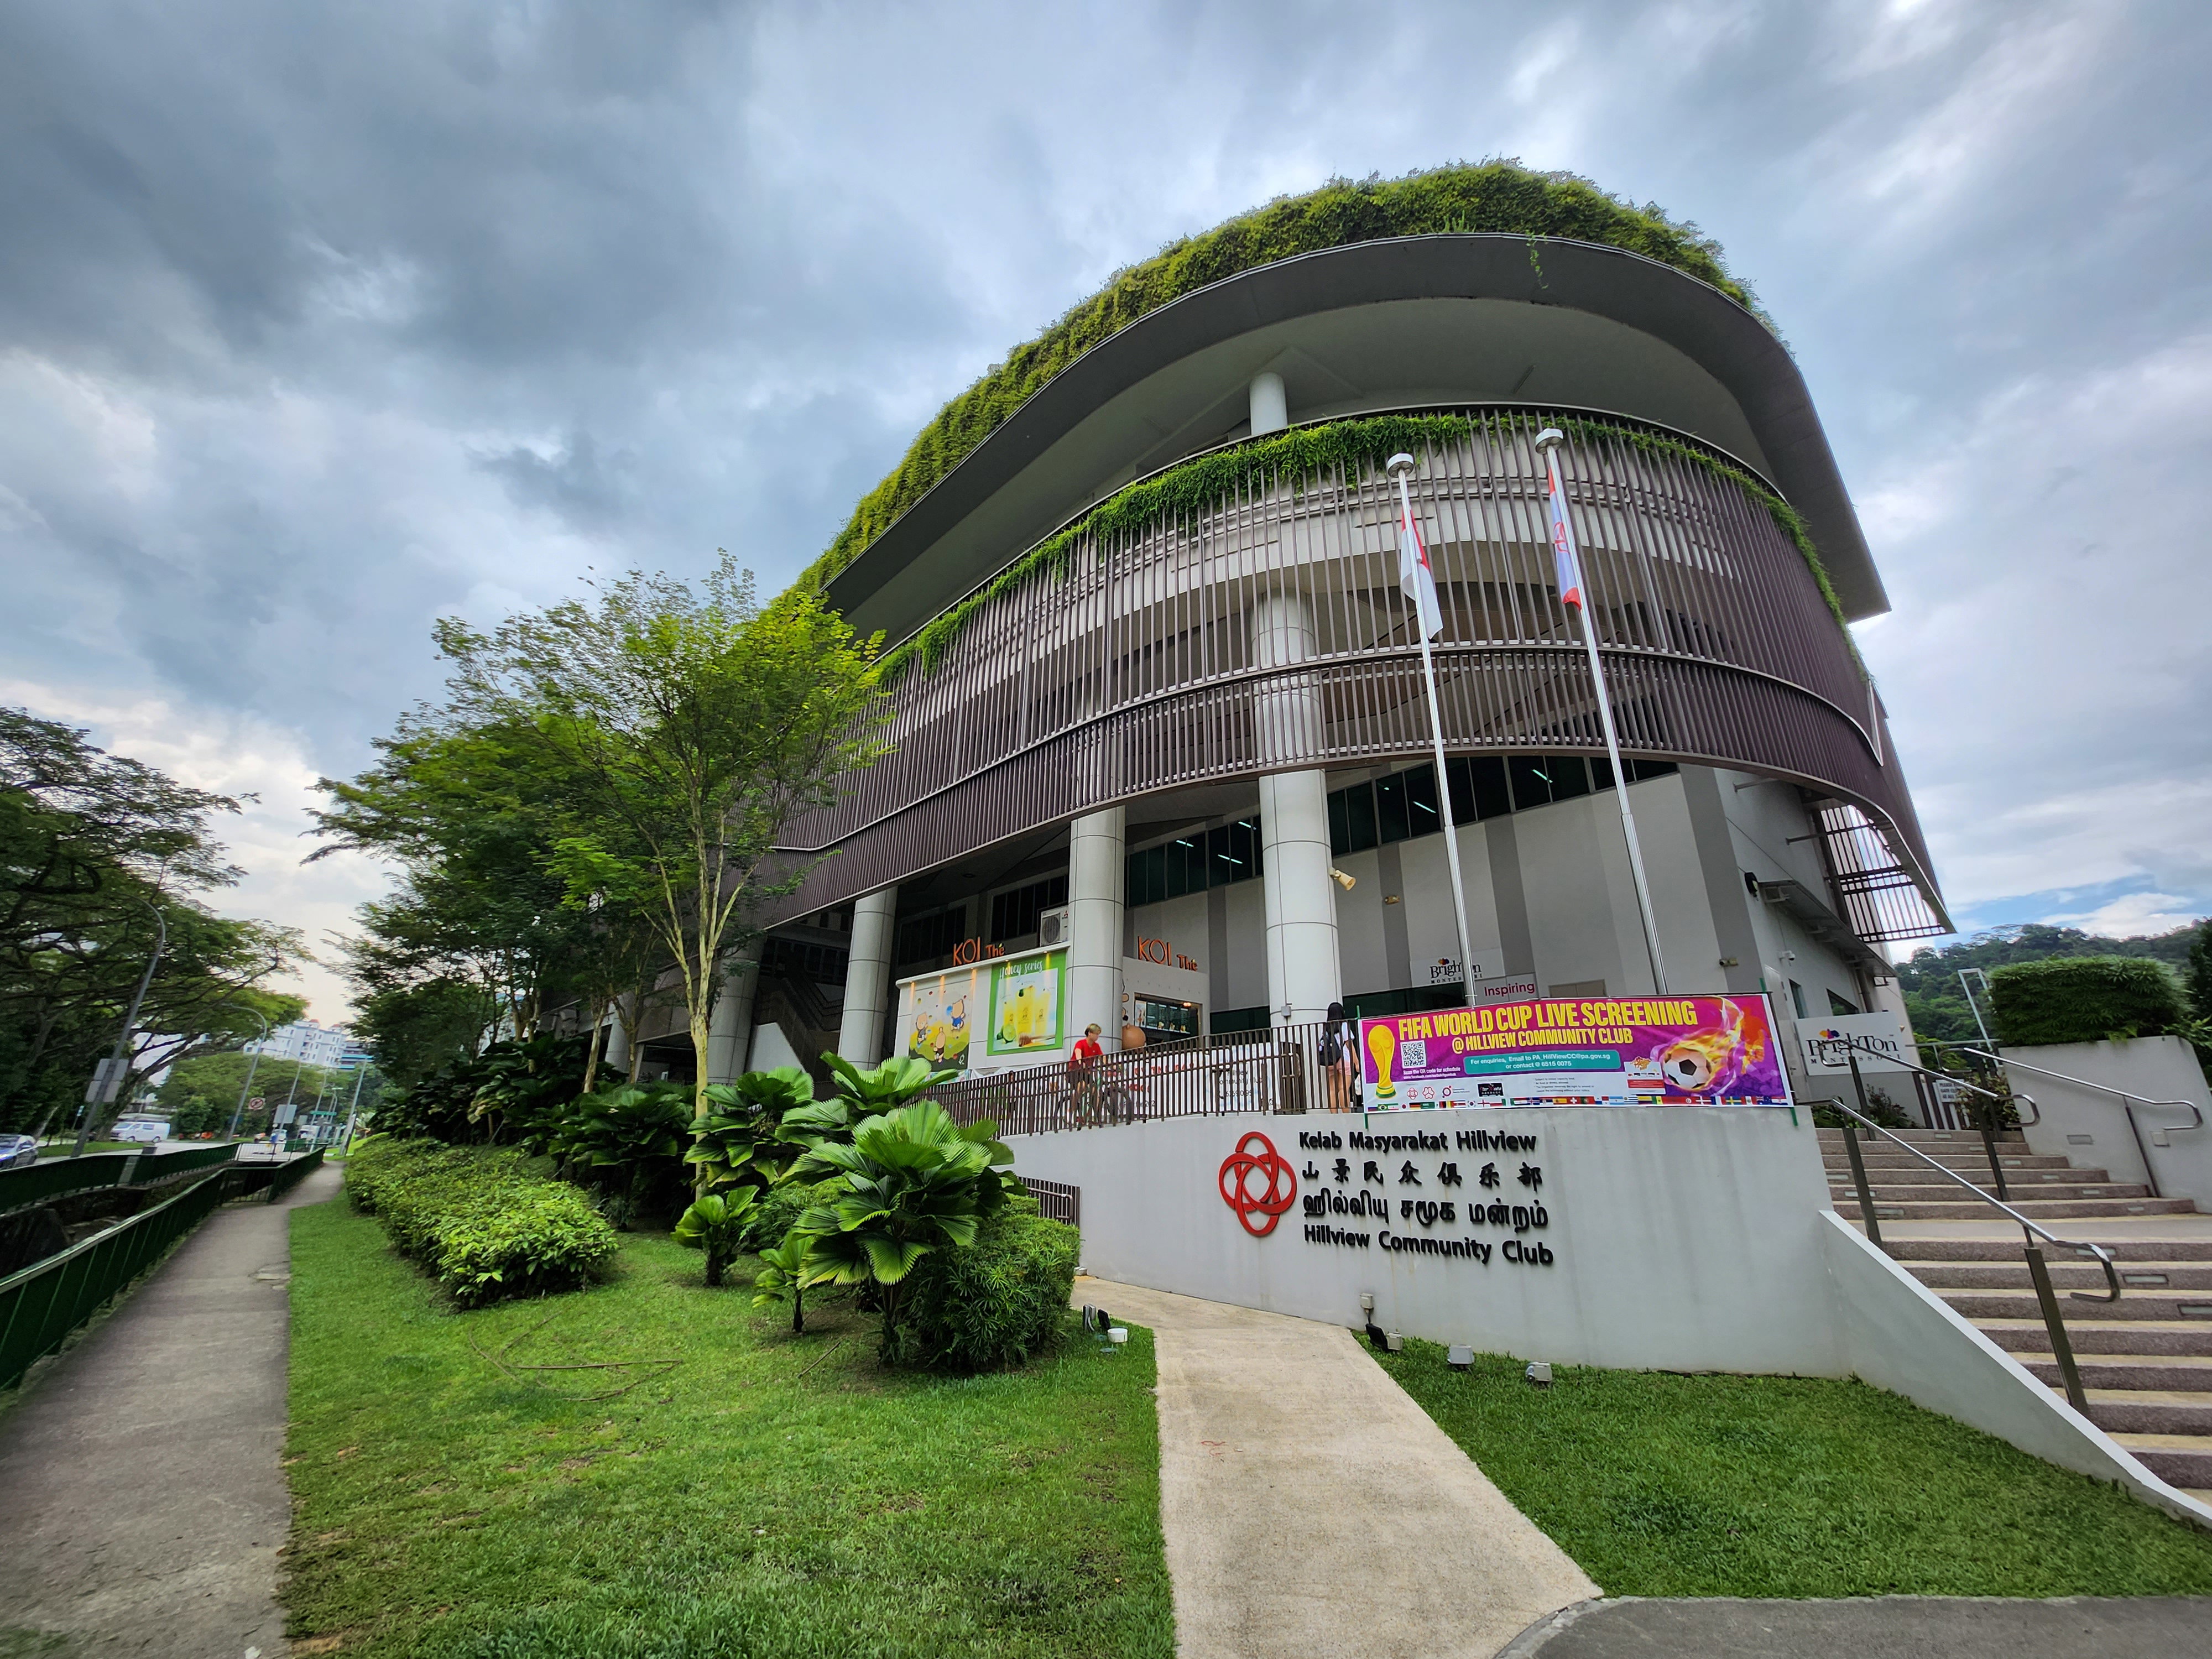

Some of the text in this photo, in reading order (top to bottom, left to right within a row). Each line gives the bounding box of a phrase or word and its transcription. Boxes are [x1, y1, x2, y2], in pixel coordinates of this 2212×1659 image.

[953, 936, 1005, 967] KOI Thé
[1138, 936, 1198, 971] KOI Thé
[1000, 966, 1021, 979] Honey
[1430, 960, 1482, 978] Brighn
[1431, 974, 1483, 984] MONTESRI
[1484, 982, 1535, 997] Inspiring
[1399, 1001, 1698, 1041] FIFA WORLD CUP LIVE SCREENING
[1452, 1028, 1634, 1054] @ HILLVIEW COMMUNITY CLUB
[1299, 1130, 1537, 1154] Kelab Masyarakat Hillview
[1302, 1158, 1543, 1192] 山景民众俱乐部
[1400, 1198, 1456, 1226] சமூக
[1468, 1197, 1549, 1233] மன்றம்
[1304, 1224, 1554, 1265] Hillview Community Club
